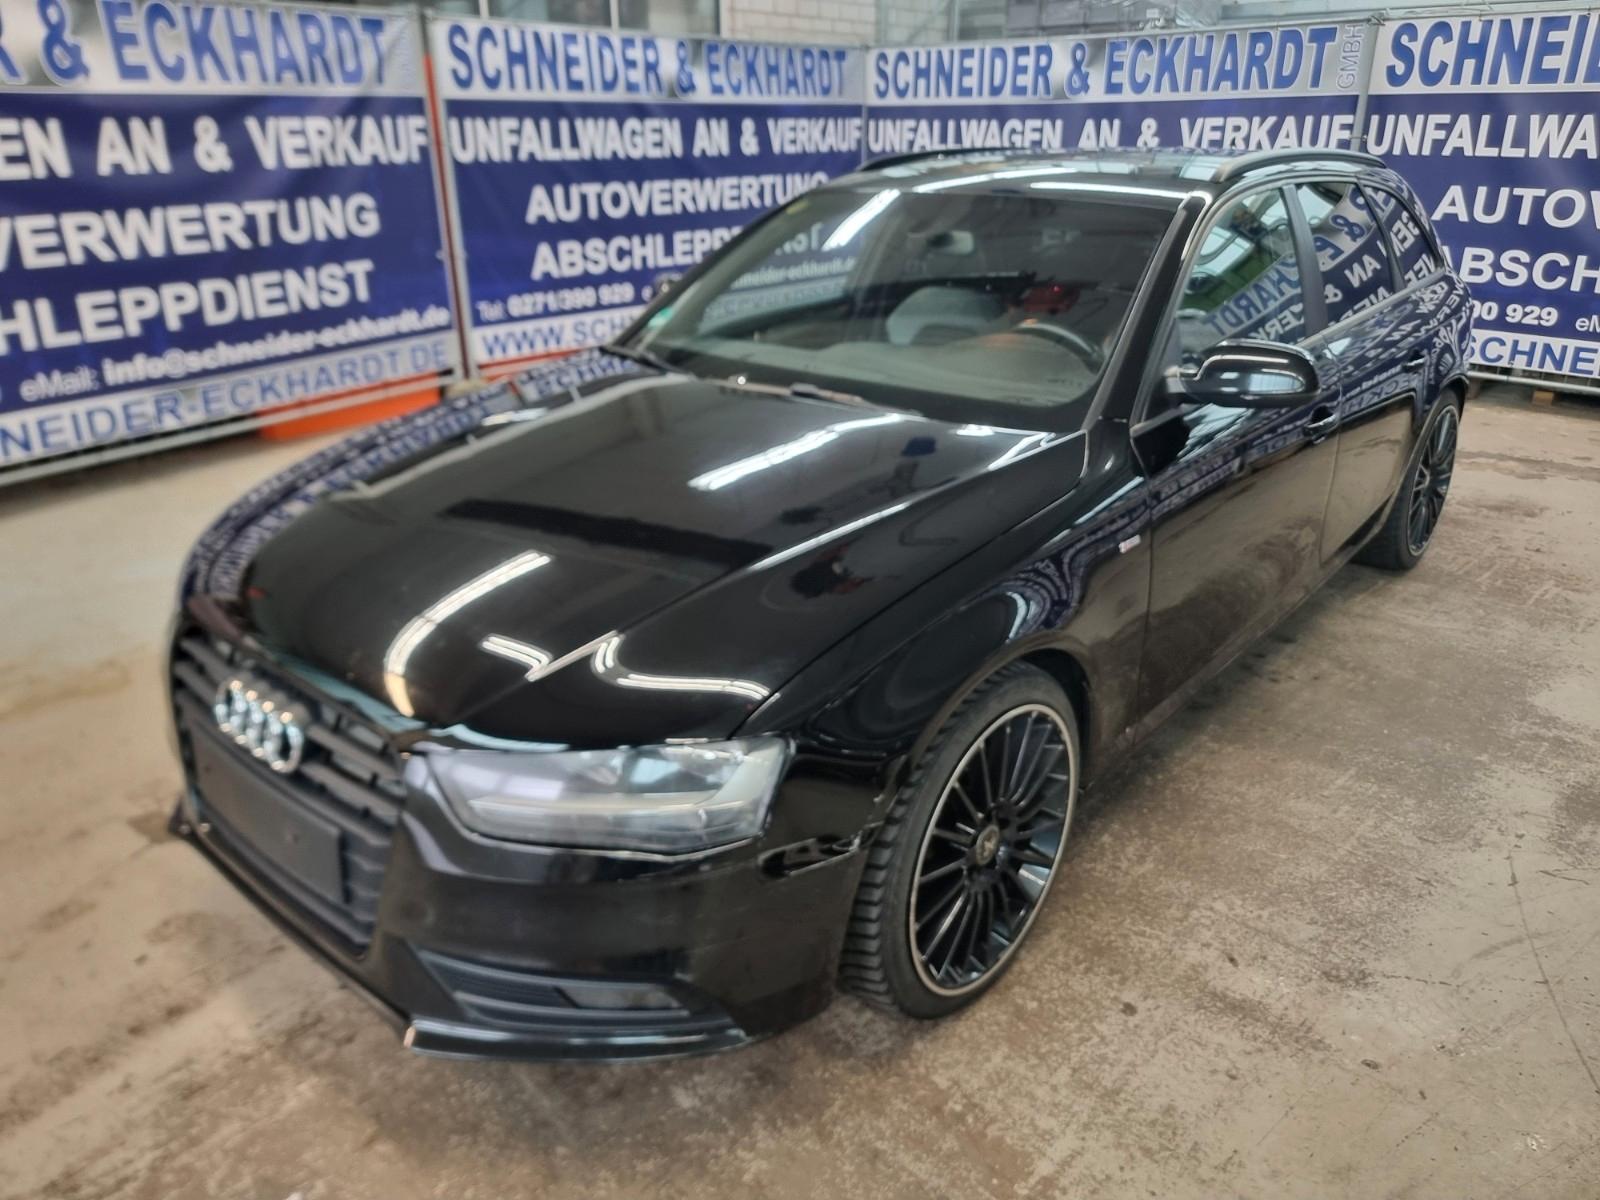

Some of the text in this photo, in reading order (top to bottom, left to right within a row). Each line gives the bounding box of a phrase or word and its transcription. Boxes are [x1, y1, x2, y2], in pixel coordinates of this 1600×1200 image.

[37, 0, 90, 80] &
[101, 1, 386, 84] ECKHARDT
[448, 24, 846, 96] SCHNEIDER & ECKHARDT
[874, 26, 1338, 98] SCHNEIDER & ECKHARDT
[1337, 24, 1366, 91] GMBH
[97, 116, 172, 176] AN
[193, 115, 233, 173] &
[243, 115, 429, 170] VERKAUF
[450, 116, 863, 163] UNFALLWAGEN AN & VERKAUF
[868, 115, 1355, 153] UNFALLWAGEN AN & VERKAUF
[0, 192, 381, 272] ERWERTUNG
[1431, 185, 1600, 229] AUTO
[531, 225, 744, 281] ABSCHLEPP
[1505, 304, 1559, 327] 929
[1470, 334, 1600, 375] CHNE
